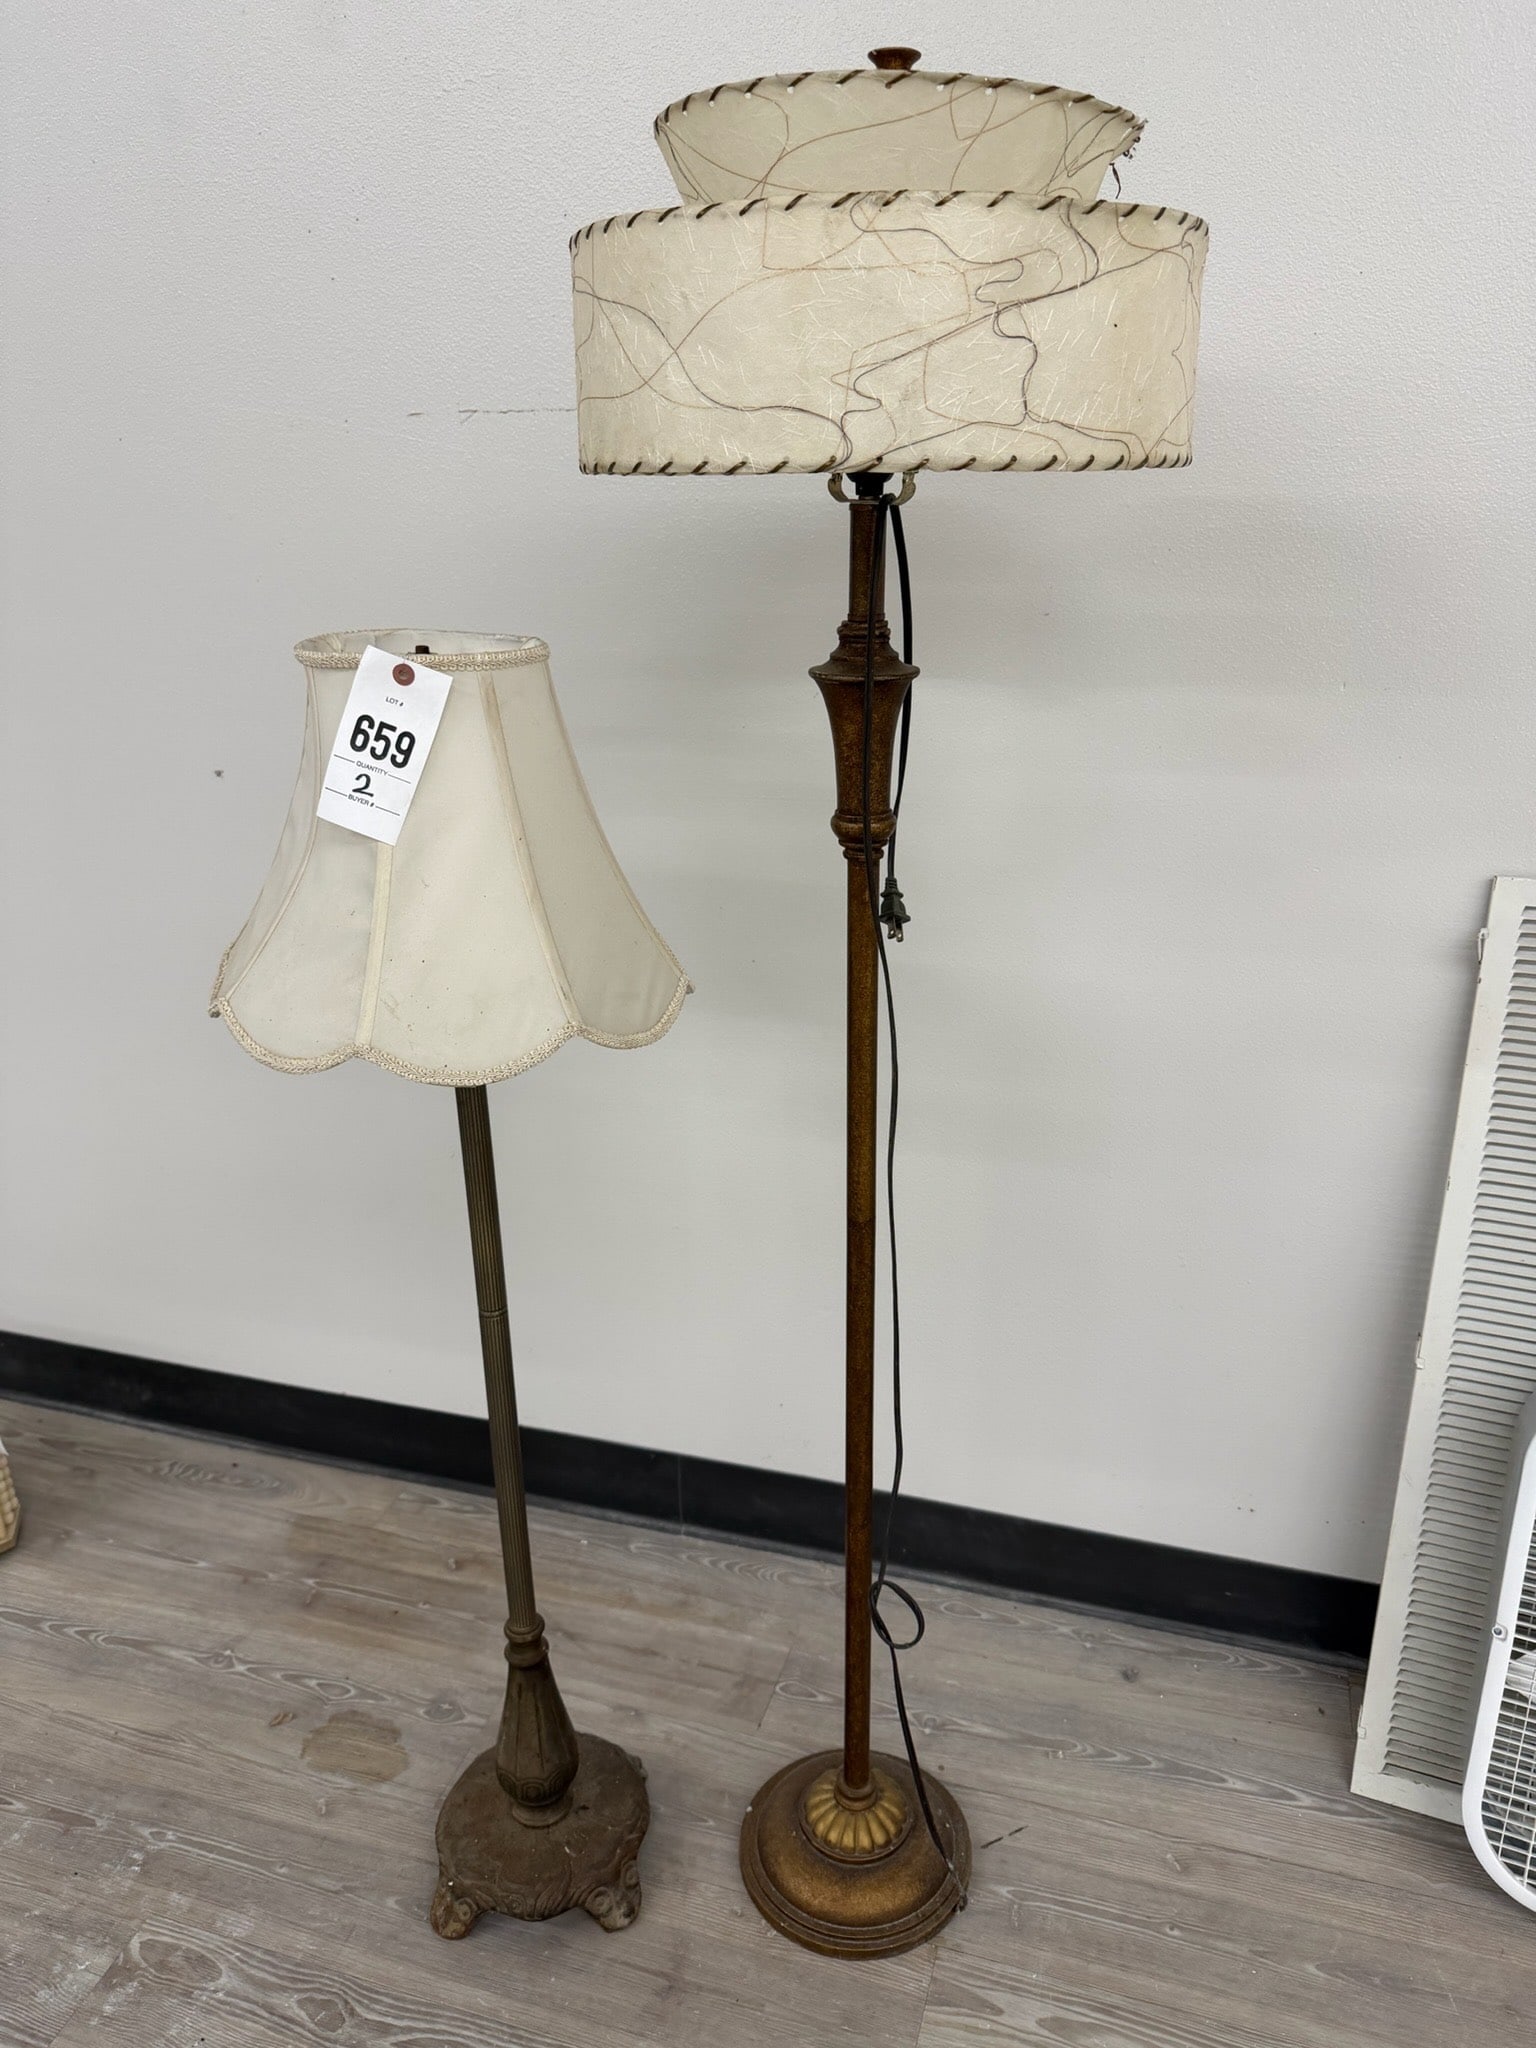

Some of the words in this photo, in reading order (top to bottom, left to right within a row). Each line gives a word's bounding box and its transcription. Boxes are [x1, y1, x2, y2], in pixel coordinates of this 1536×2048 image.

[385, 696, 399, 706] LOT
[350, 714, 416, 769] 659
[356, 760, 389, 776] QUANTITY
[352, 773, 374, 797] 2
[347, 794, 370, 807] BUYER
